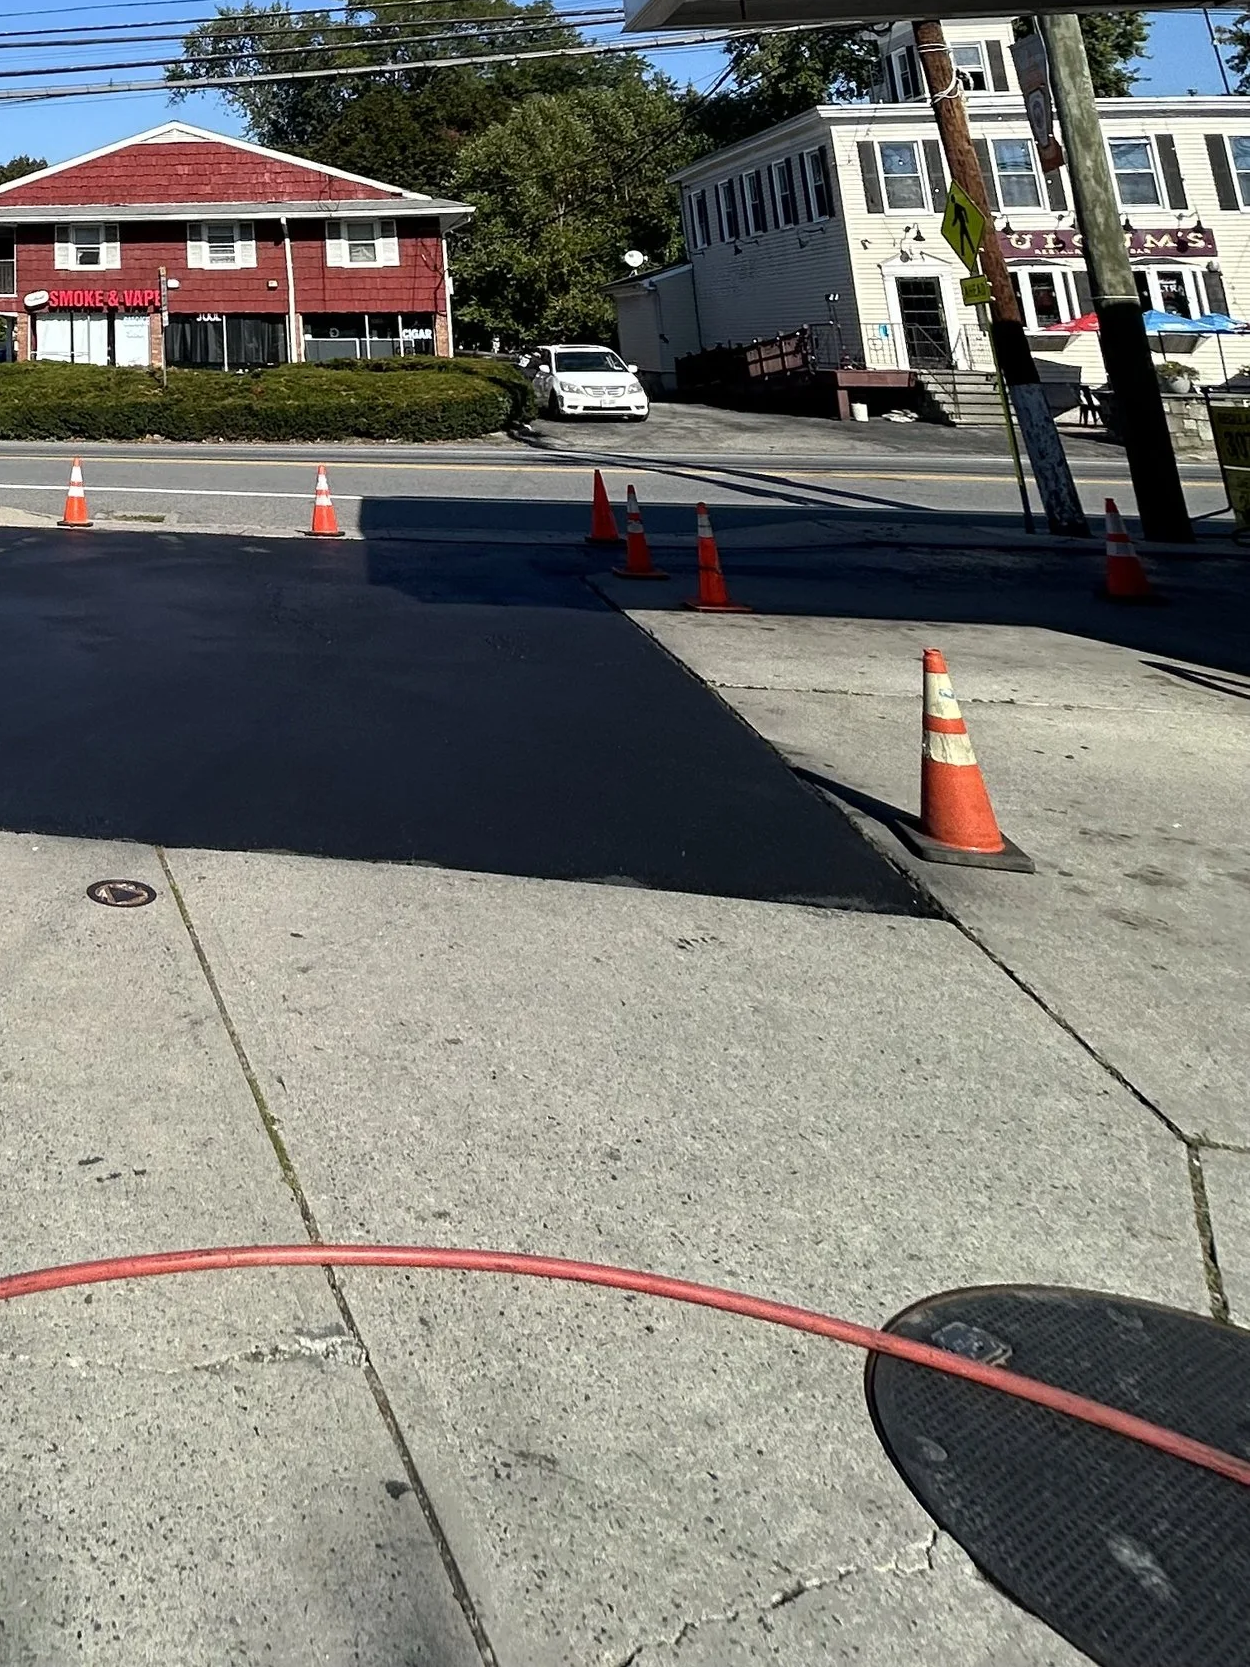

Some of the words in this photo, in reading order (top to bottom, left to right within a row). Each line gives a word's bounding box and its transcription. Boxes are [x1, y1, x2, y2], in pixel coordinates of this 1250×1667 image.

[50, 290, 104, 307] SMOKE
[107, 290, 119, 307] &
[123, 290, 161, 307] VAPE
[402, 328, 433, 340] CIGAR
